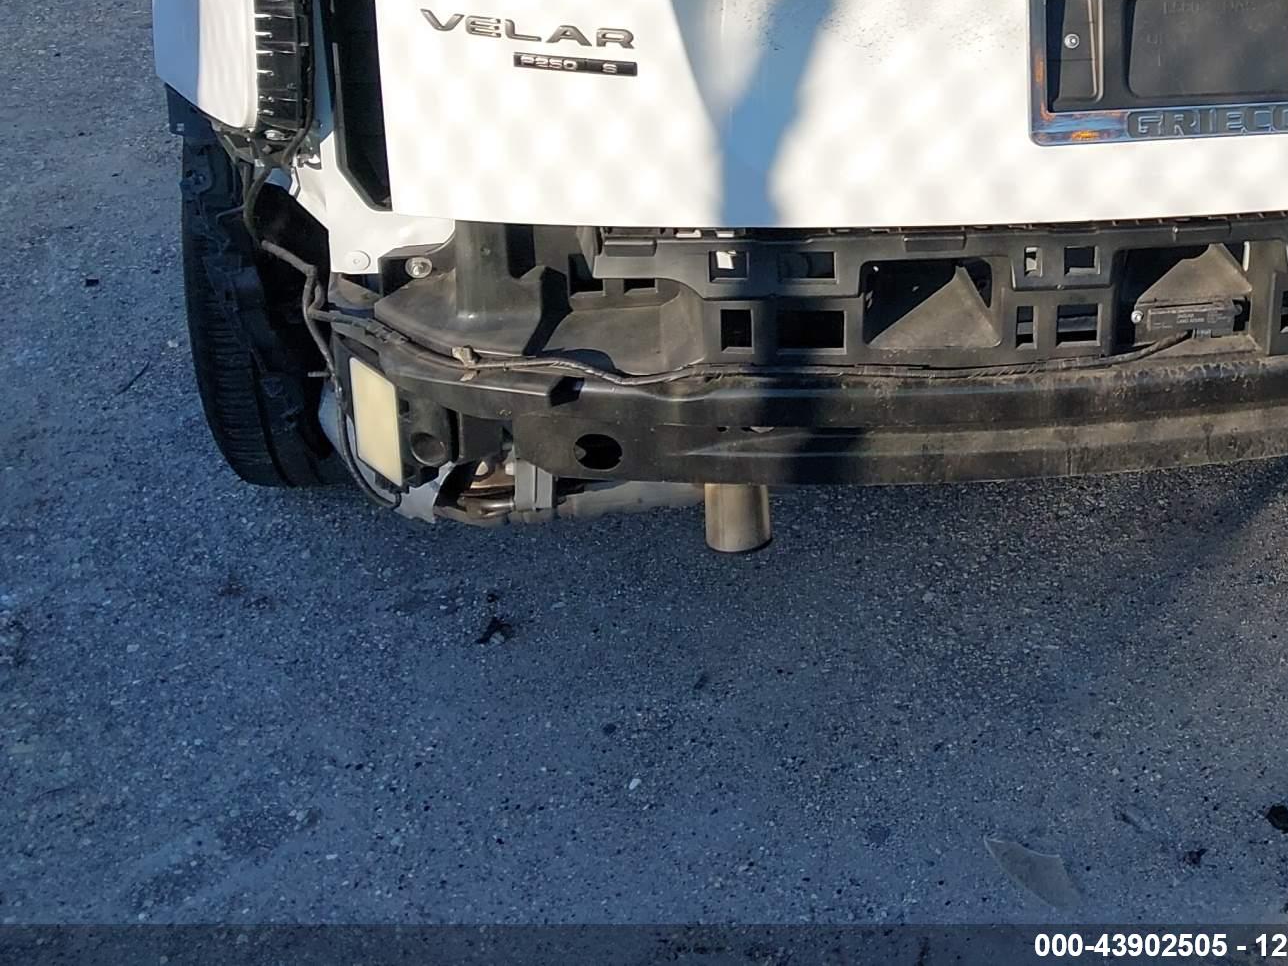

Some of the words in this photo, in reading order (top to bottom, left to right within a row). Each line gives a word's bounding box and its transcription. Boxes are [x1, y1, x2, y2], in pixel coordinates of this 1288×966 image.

[419, 8, 635, 50] VELAR
[520, 55, 578, 71] P250
[602, 62, 618, 74] S
